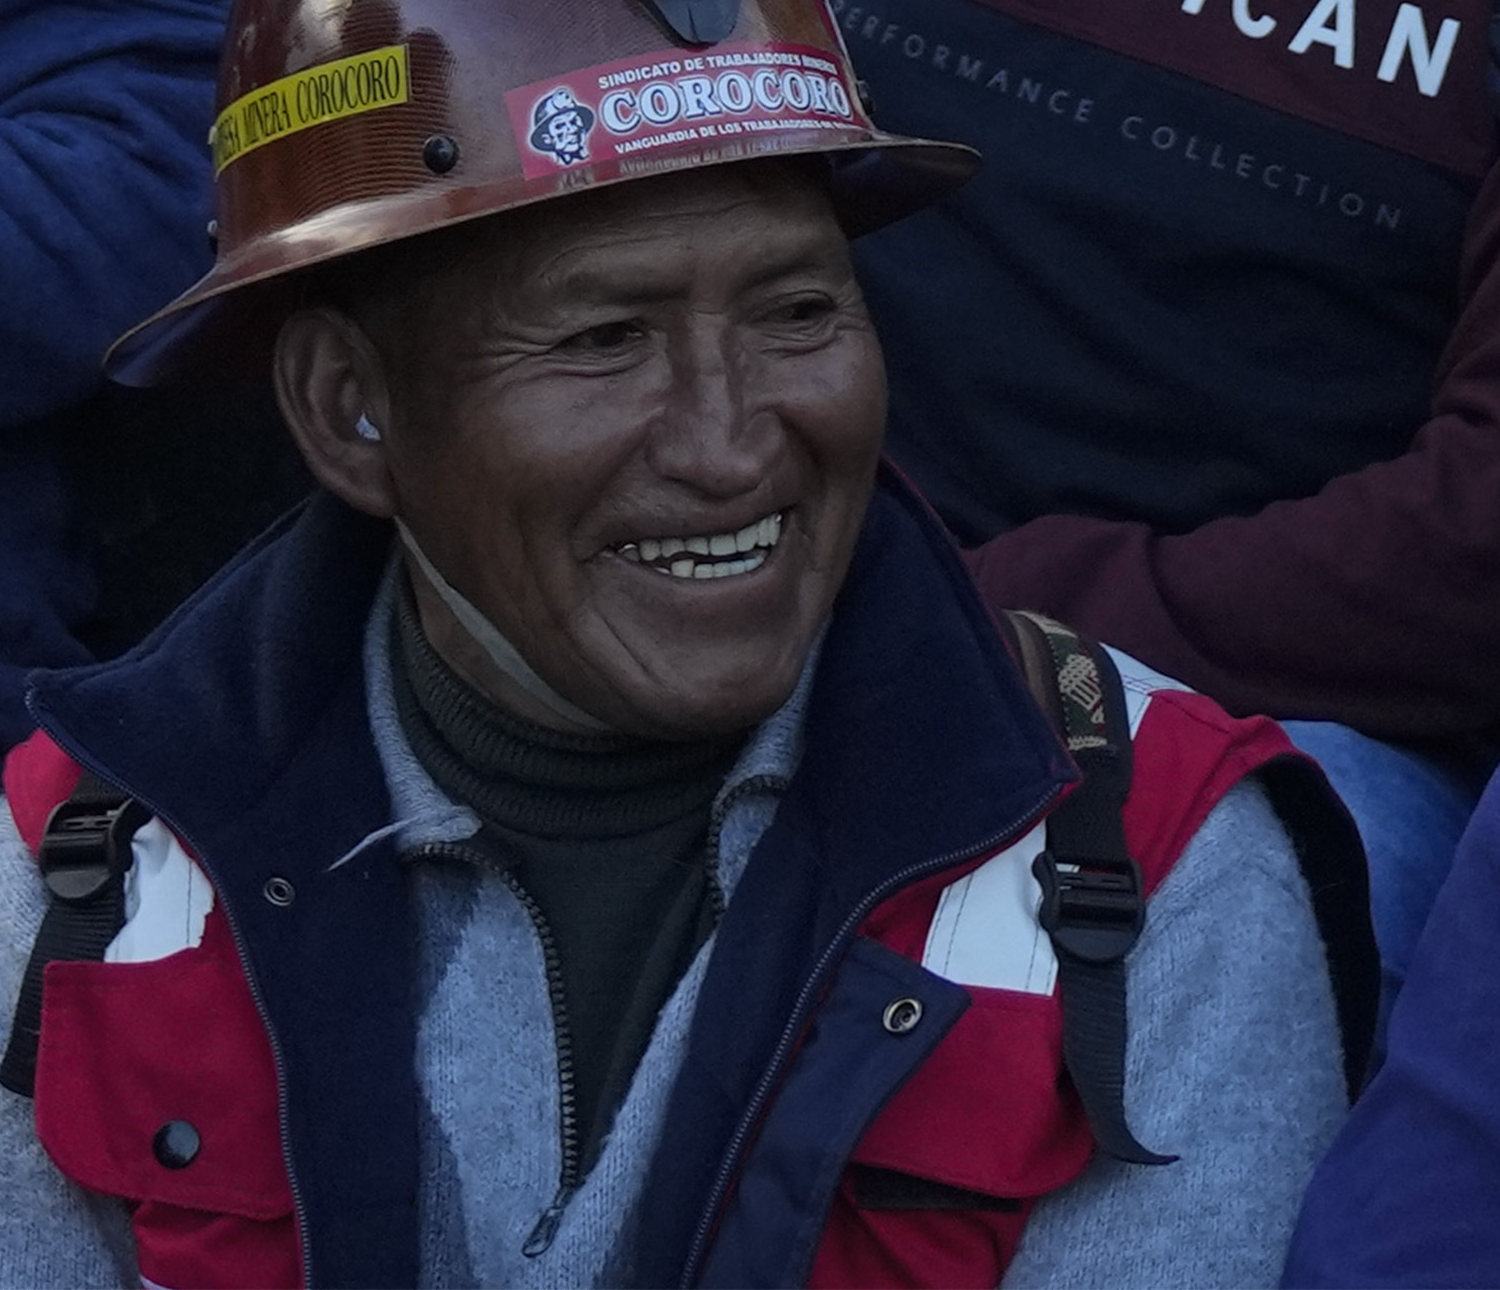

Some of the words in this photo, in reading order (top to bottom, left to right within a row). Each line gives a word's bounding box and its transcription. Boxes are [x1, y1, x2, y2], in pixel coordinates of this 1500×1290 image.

[296, 54, 401, 125] COROCORO
[598, 62, 682, 90] SINDICATO
[686, 57, 704, 72] DE
[706, 52, 802, 71] TRABAJADORES
[600, 68, 854, 135] COROCORO
[613, 131, 698, 155] VANGUARDIA
[699, 124, 718, 139] DE
[717, 121, 743, 136] LOS
[1122, 114, 1401, 229] COLLECTION
